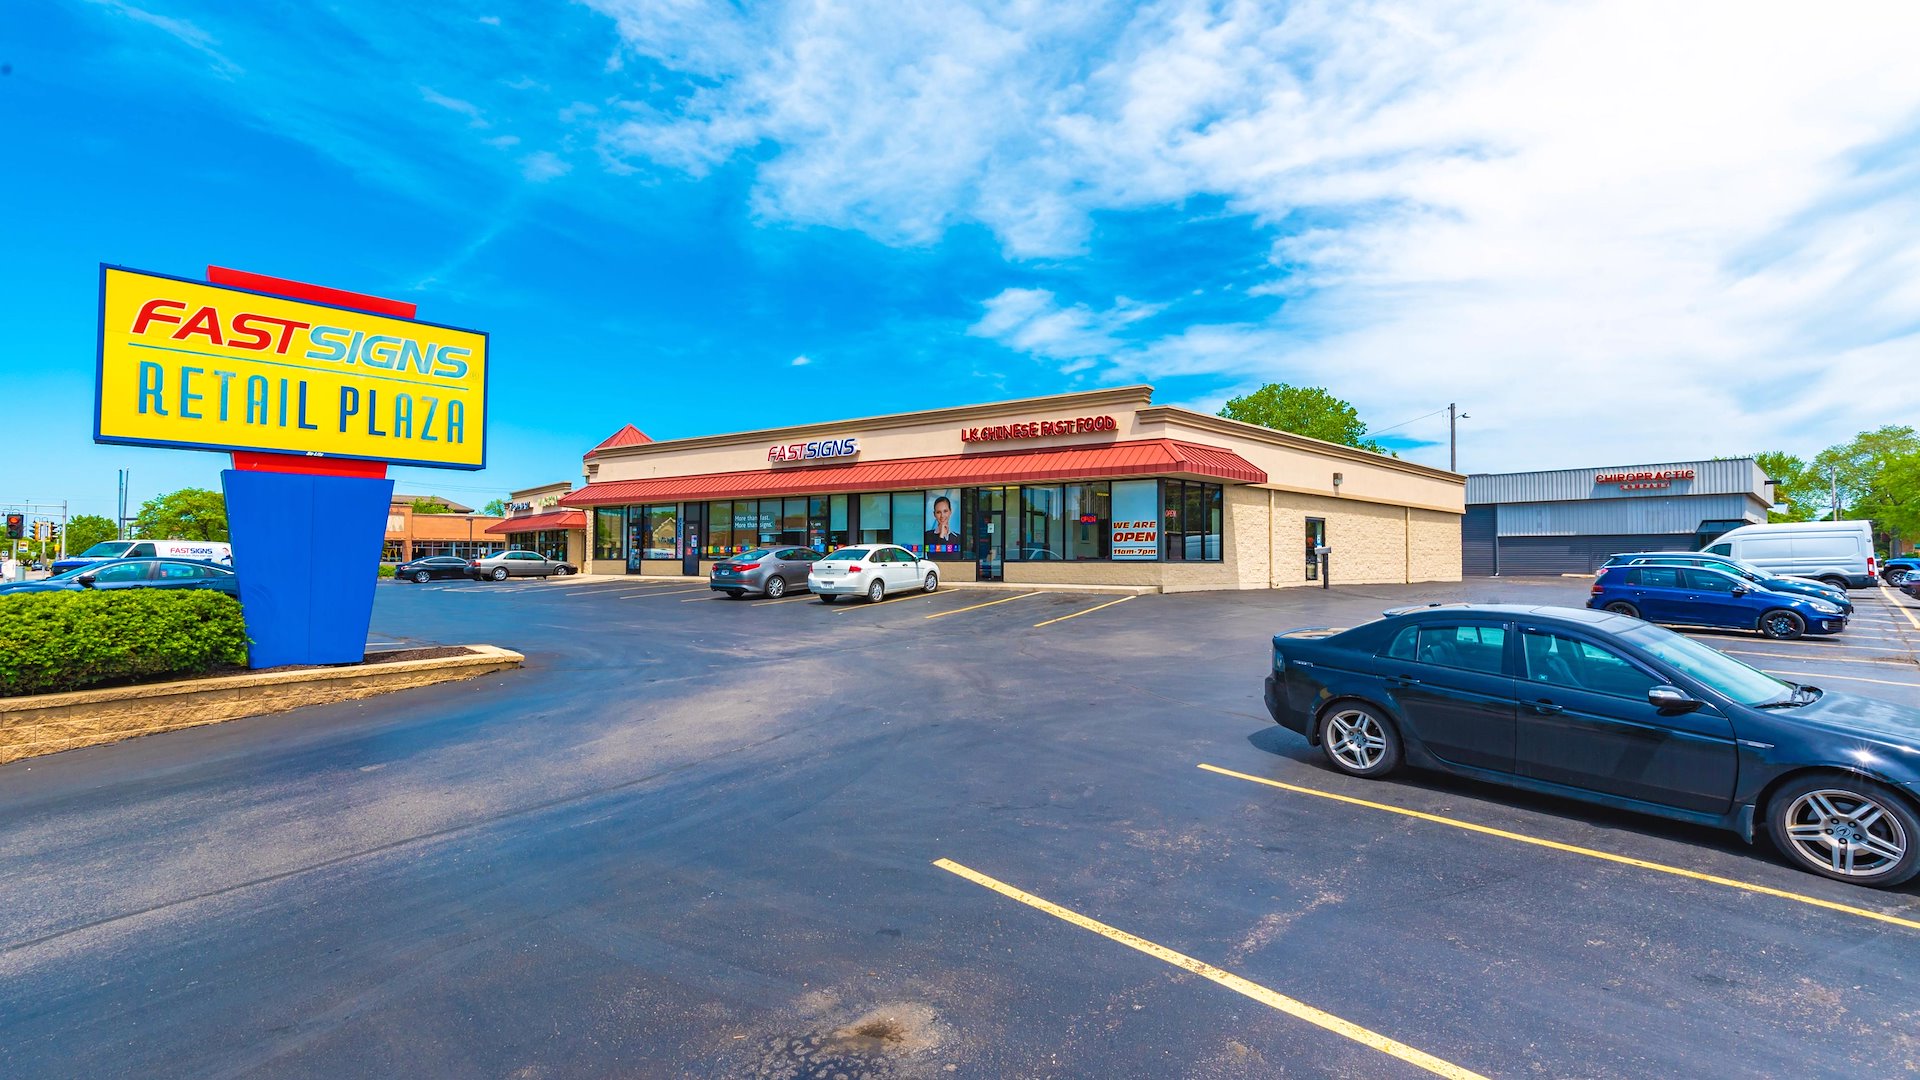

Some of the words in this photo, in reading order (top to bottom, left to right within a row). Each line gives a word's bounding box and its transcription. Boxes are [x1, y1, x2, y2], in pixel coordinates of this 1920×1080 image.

[131, 298, 472, 379] FASTSIGNS
[138, 360, 318, 430] RETAIL
[339, 385, 465, 444] PLAZA
[980, 421, 1040, 441] CHINESE
[1040, 420, 1076, 436] FAST
[1076, 415, 1117, 433] FOOD
[767, 438, 856, 462] FASTSIGNS
[1596, 469, 1695, 484] CHIROPRACTIC
[1080, 515, 1096, 523] OPEN
[1133, 521, 1156, 529] ARE
[1113, 531, 1157, 543] OPEN
